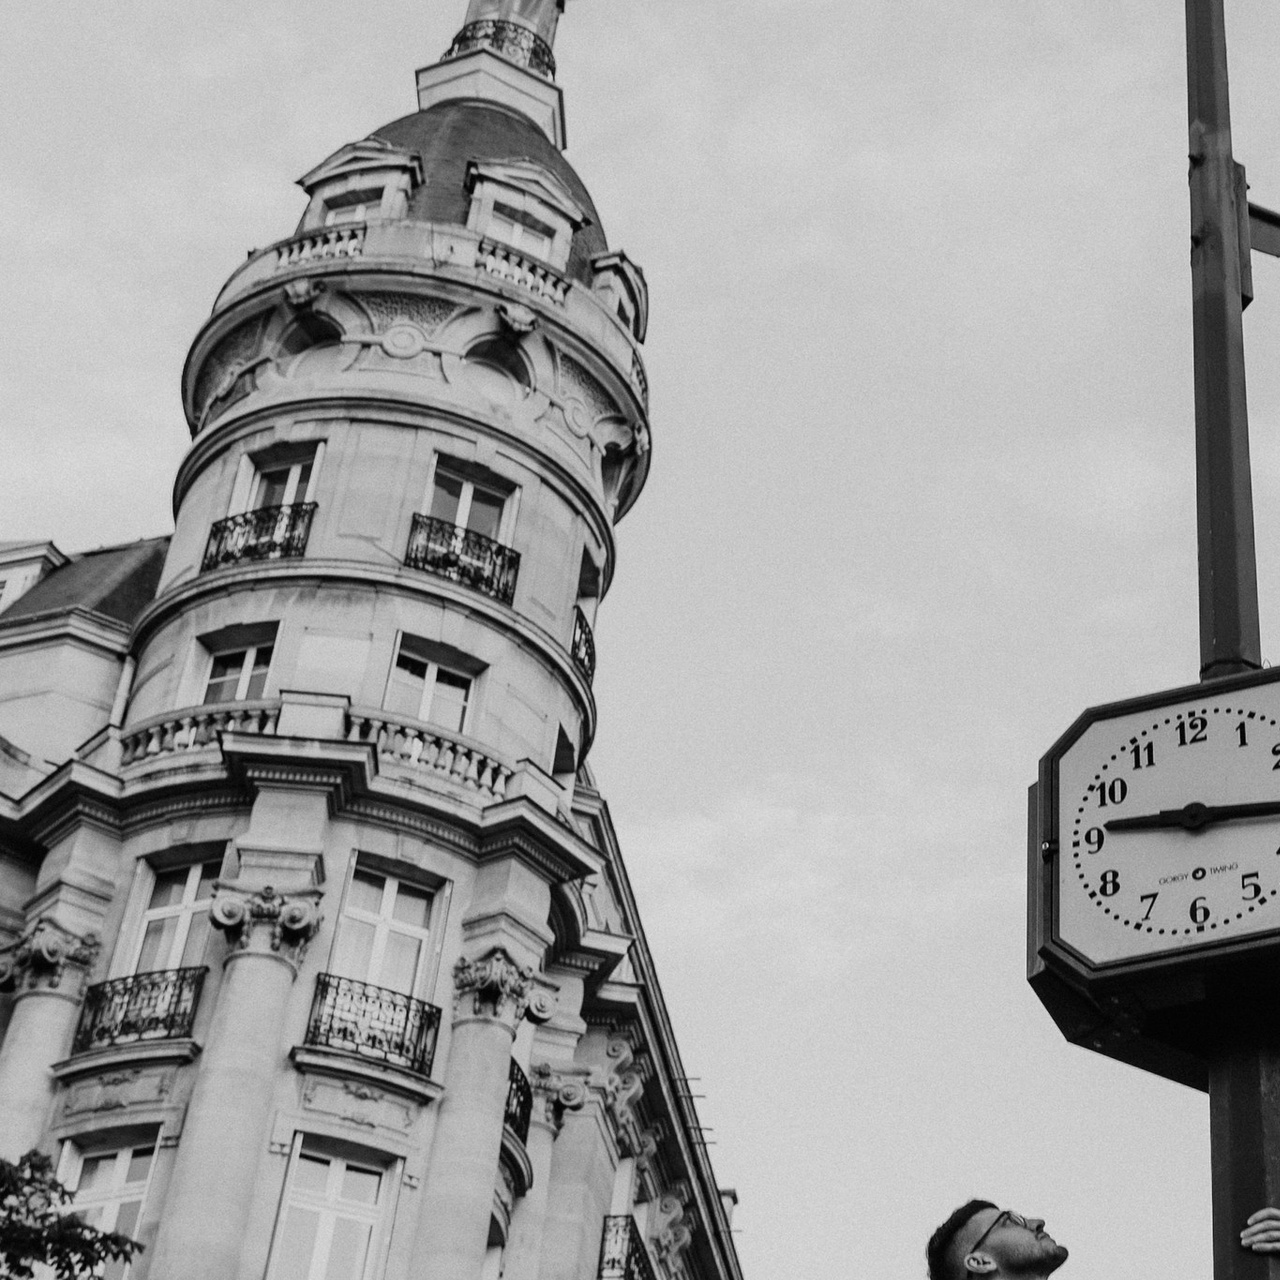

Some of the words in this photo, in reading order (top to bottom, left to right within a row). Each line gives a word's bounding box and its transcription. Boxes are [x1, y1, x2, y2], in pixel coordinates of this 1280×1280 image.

[1175, 716, 1208, 747] 12
[1235, 721, 1248, 748] 1
[1130, 741, 1155, 770] 11
[1096, 778, 1127, 808] 10
[1085, 827, 1104, 854] 9
[1099, 869, 1120, 897] 8
[1241, 871, 1261, 900] 5
[1140, 892, 1159, 921] 7
[1189, 896, 1210, 924] 6
